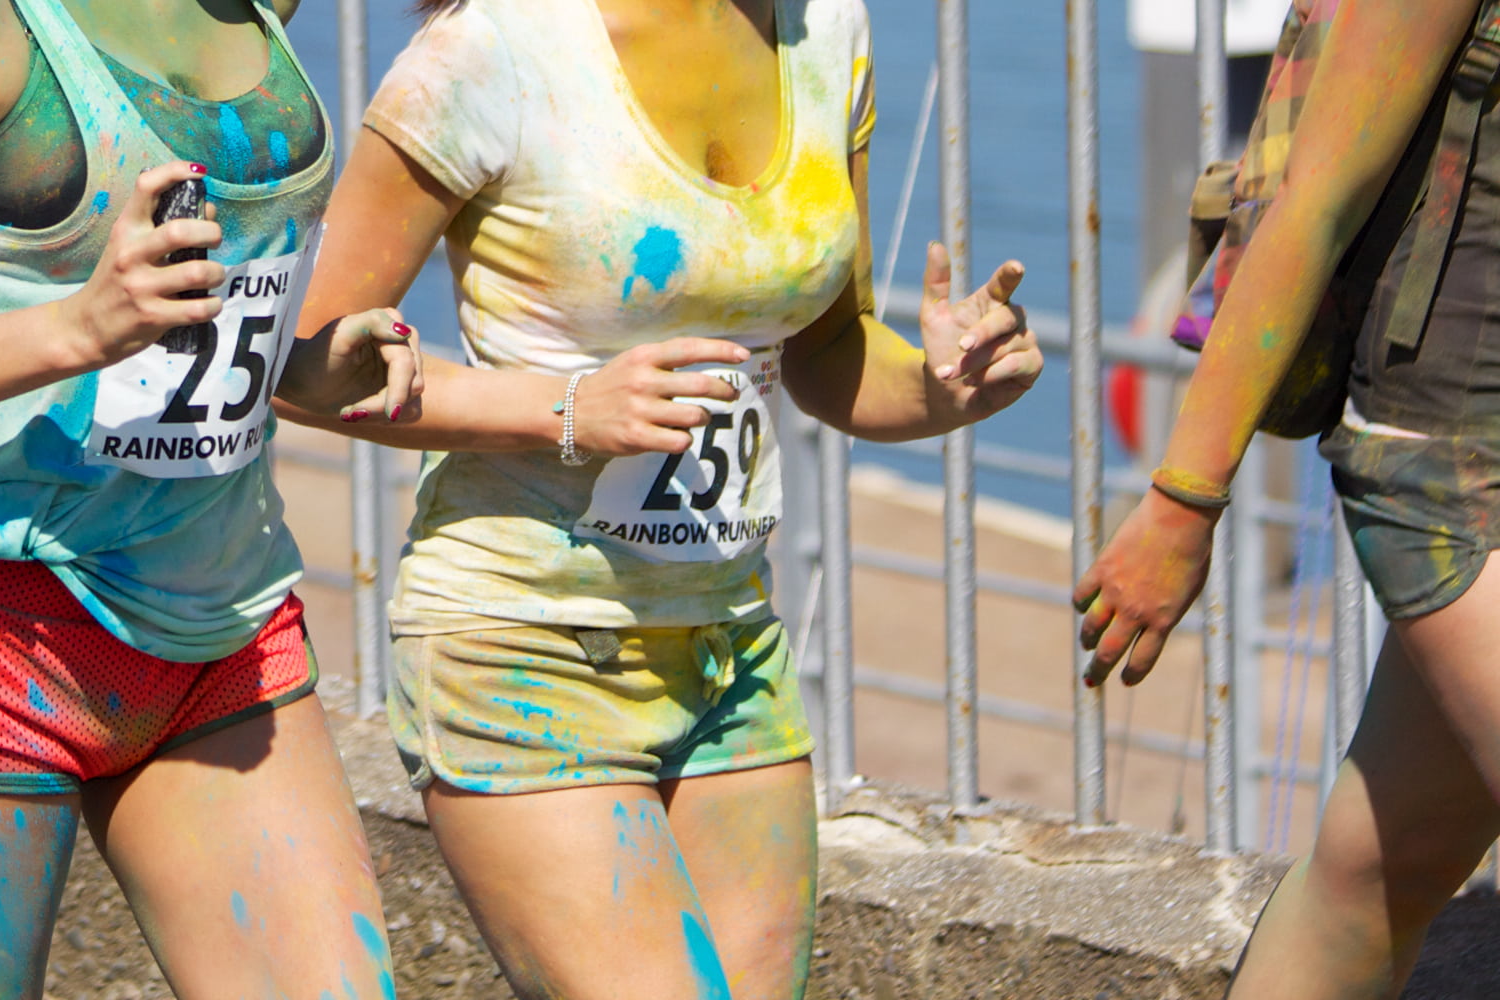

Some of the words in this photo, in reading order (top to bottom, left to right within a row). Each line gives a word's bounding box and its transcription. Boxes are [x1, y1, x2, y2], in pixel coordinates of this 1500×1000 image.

[228, 271, 289, 298] FUN!
[158, 313, 279, 424] 25
[102, 431, 242, 460] RAINBOW
[640, 407, 760, 511] 259
[591, 519, 709, 545] RAINBOW
[717, 515, 777, 543] RUNNER
